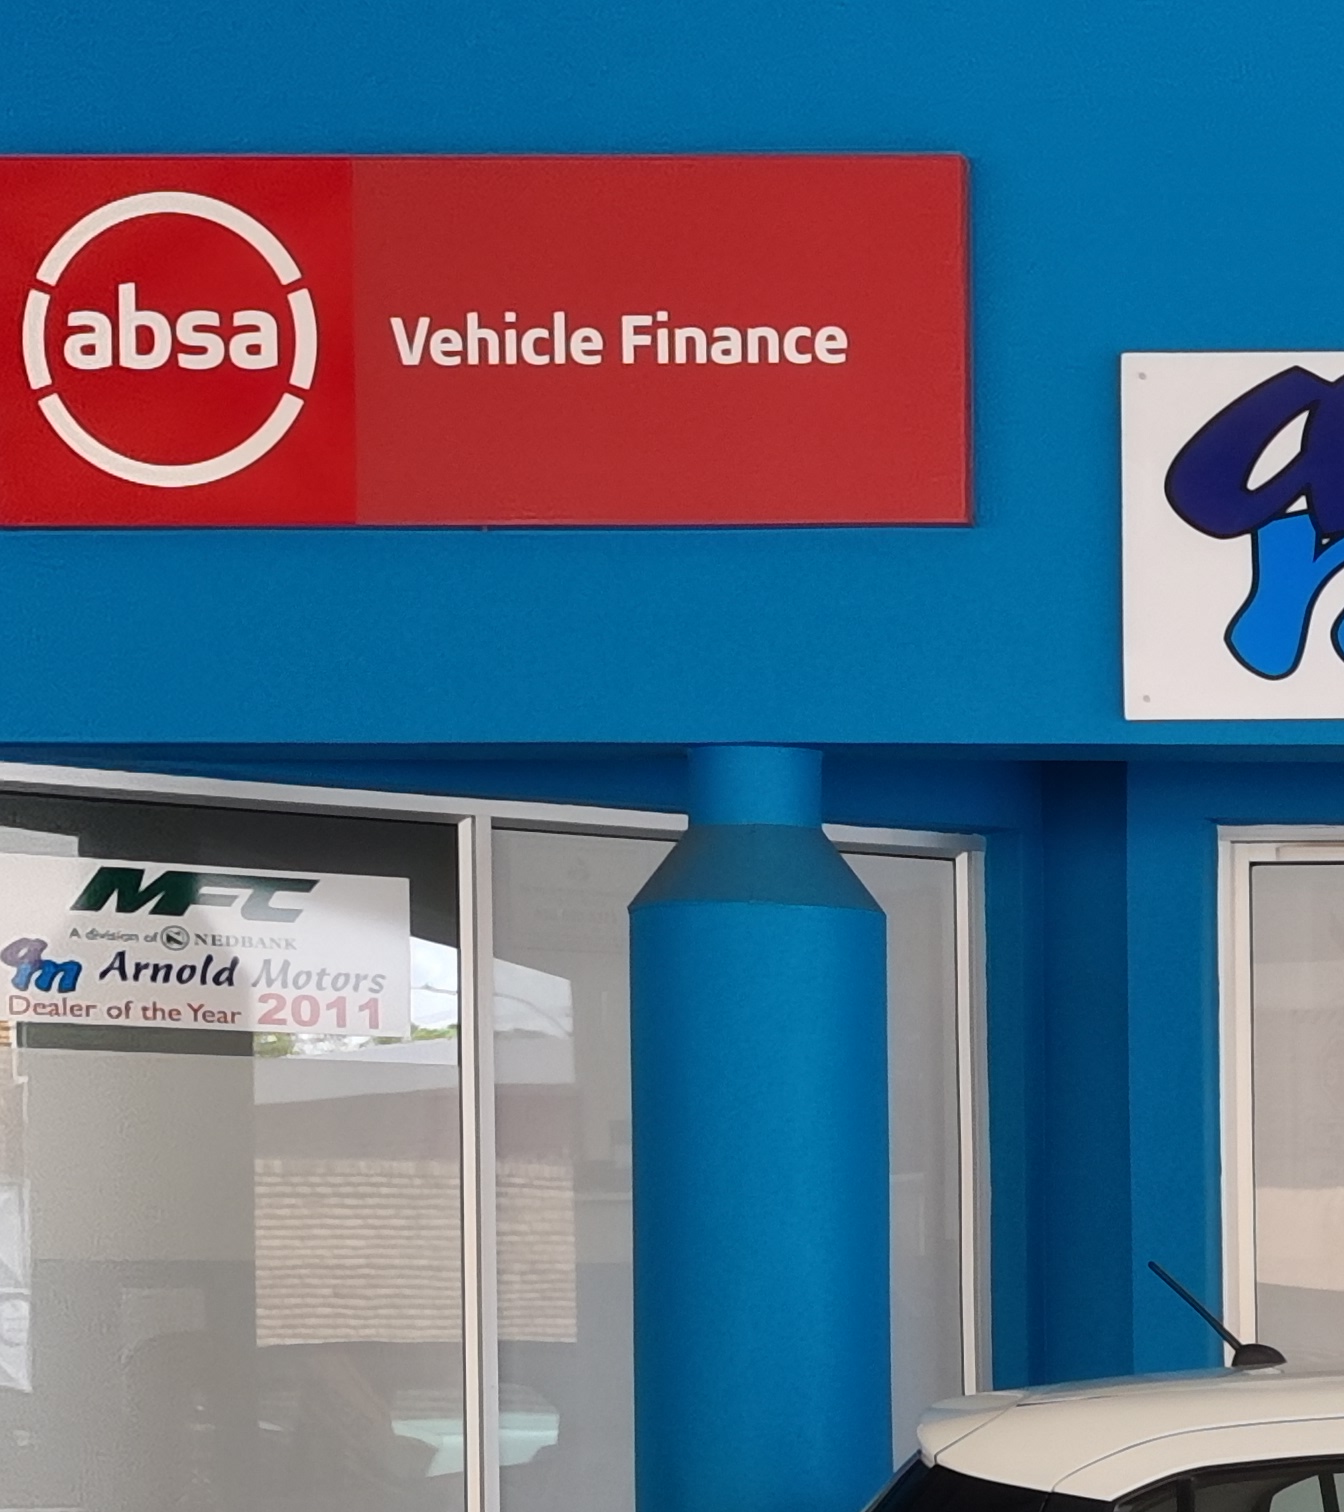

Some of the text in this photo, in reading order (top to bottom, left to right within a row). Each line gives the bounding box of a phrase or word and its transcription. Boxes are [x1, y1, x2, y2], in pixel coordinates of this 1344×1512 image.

[63, 281, 280, 370] absa
[390, 311, 848, 366] Vehicle Finance
[70, 866, 321, 923] MFC
[69, 928, 299, 950] A division of NEDBANK
[99, 950, 388, 994] Arnold Motors
[8, 993, 381, 1030] Dealer of the Year 2011
